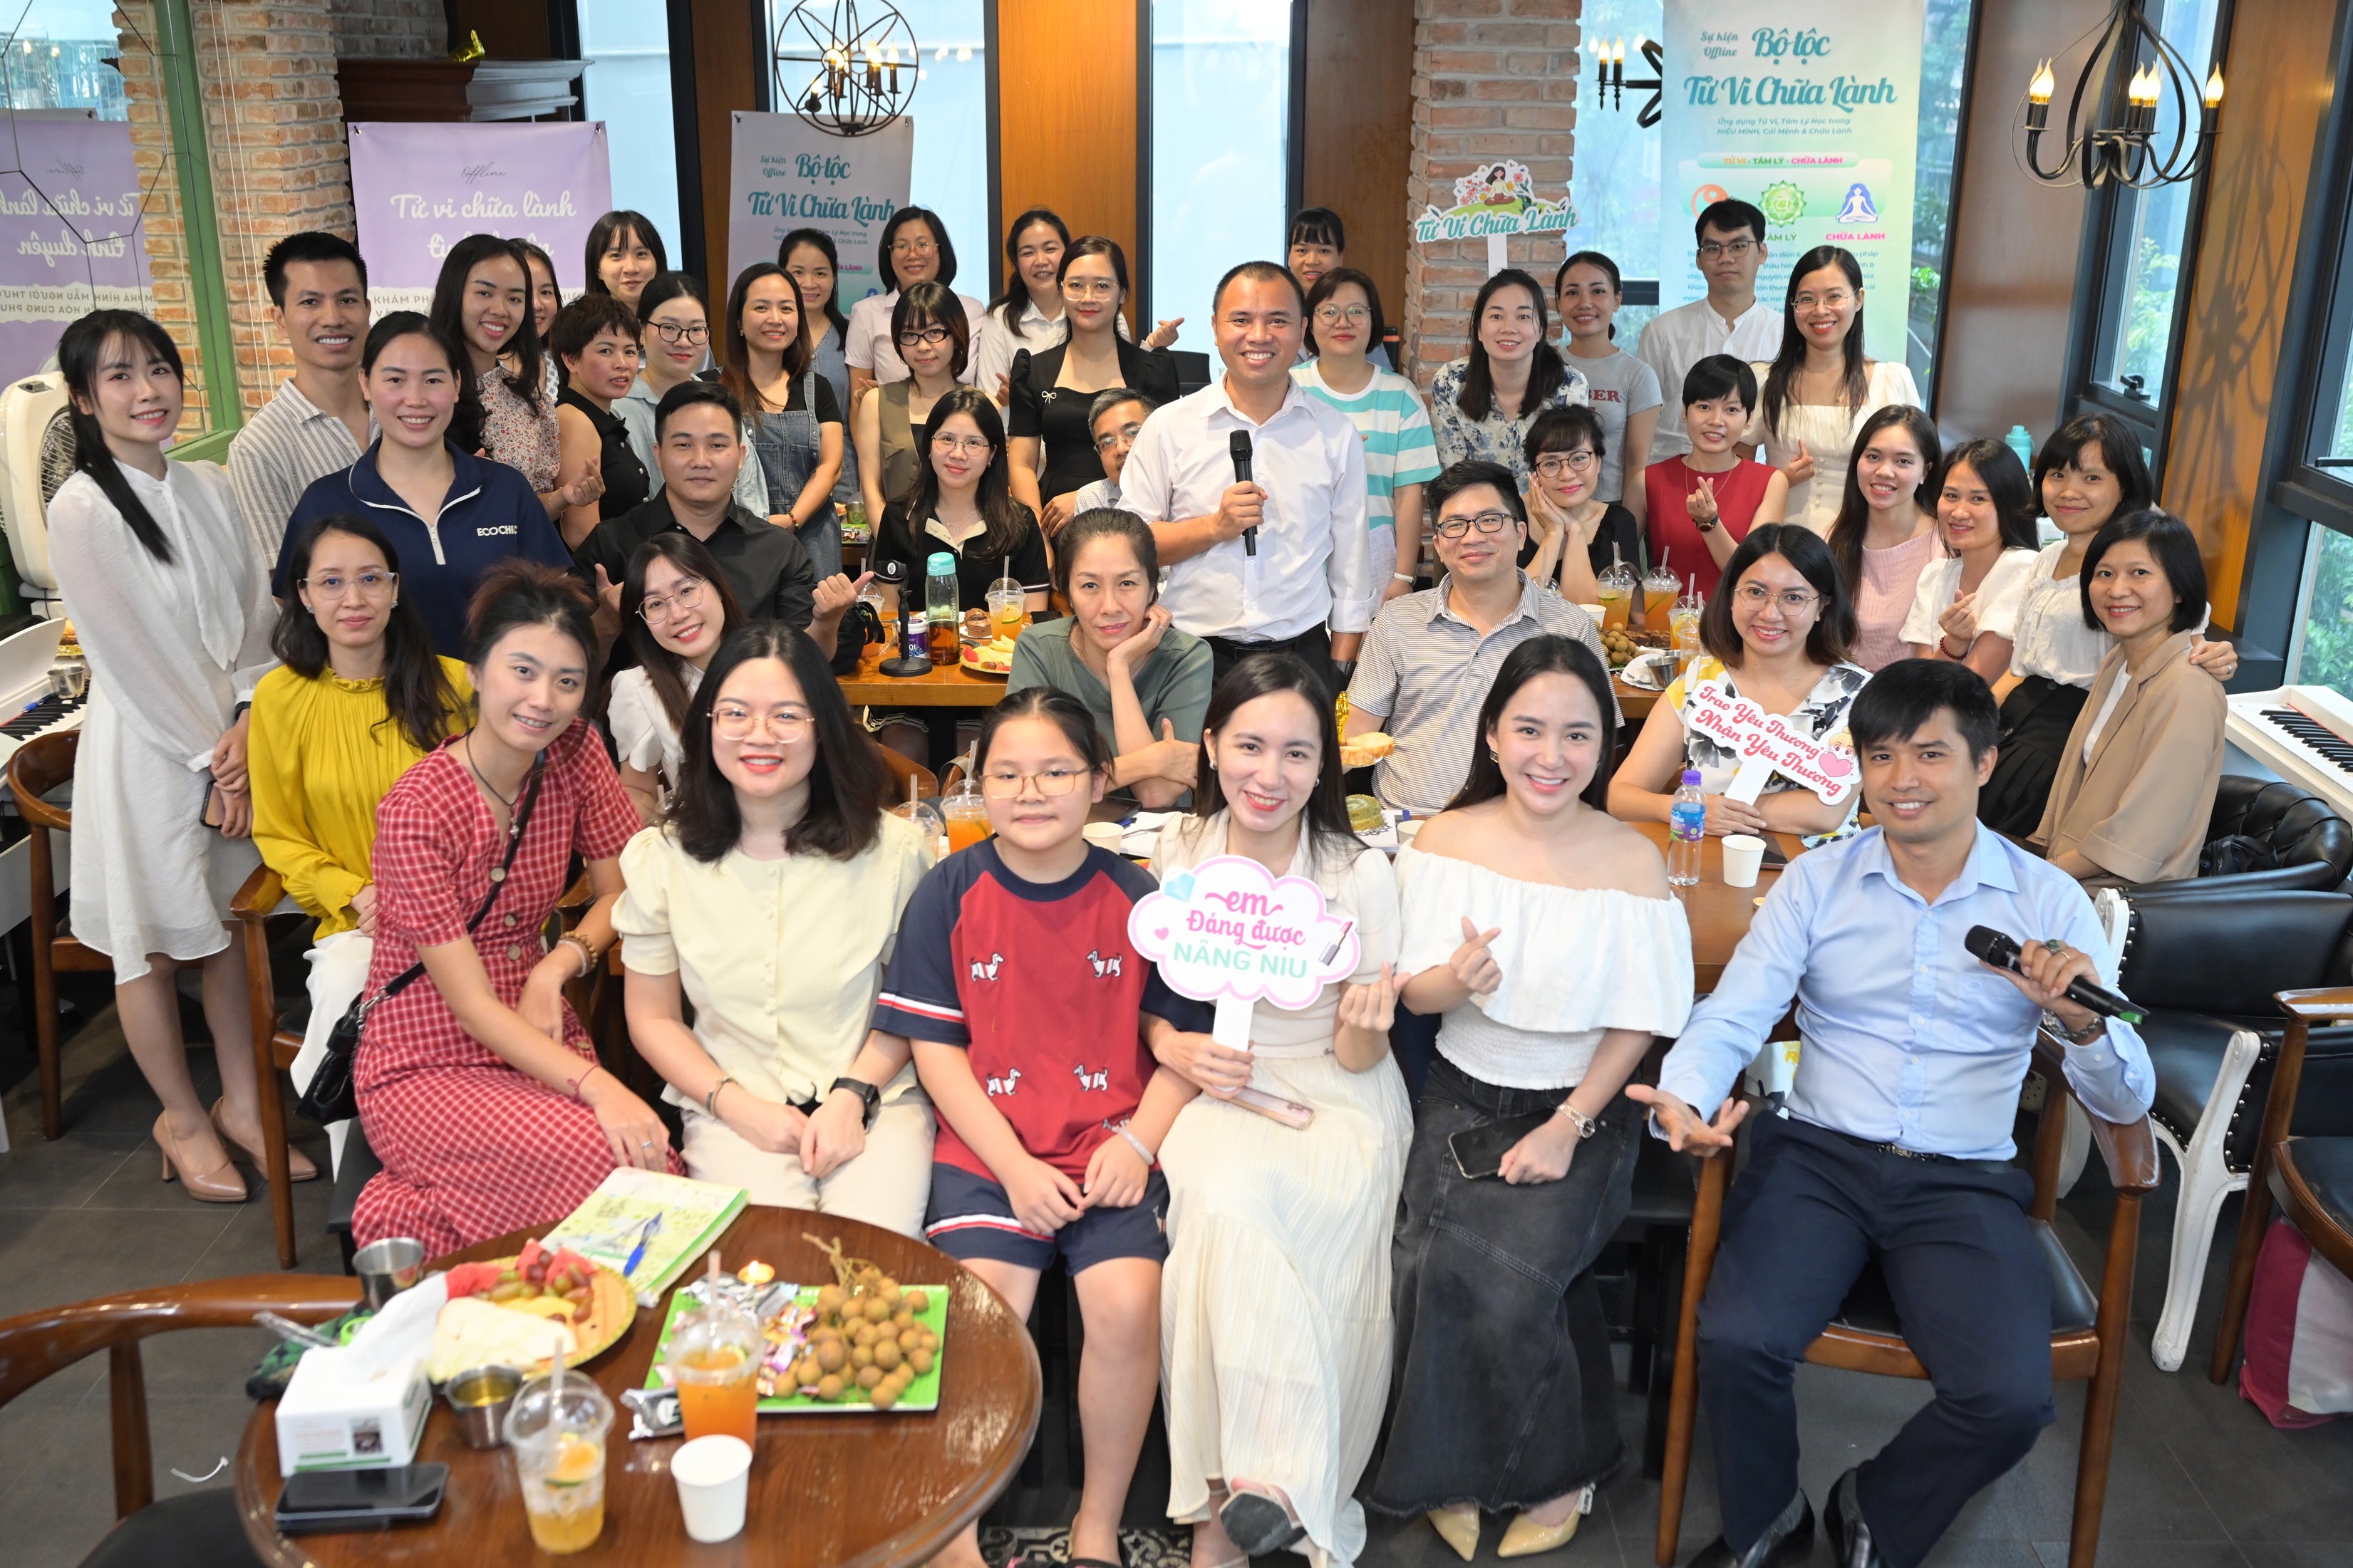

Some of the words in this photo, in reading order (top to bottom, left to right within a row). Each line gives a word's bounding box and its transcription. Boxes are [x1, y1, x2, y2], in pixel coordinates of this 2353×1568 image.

[1700, 31, 1714, 42] Sự
[1717, 31, 1739, 42] kiện
[1703, 46, 1737, 59] Offline
[1752, 27, 1794, 65] Bộ
[1794, 27, 1831, 65] tộc
[1683, 75, 1719, 105] Tử
[1721, 76, 1752, 105] Vi
[1755, 76, 1826, 105] Chữa
[1829, 75, 1898, 113] Lành
[461, 161, 507, 184] Offline
[762, 167, 787, 179] Offline
[795, 152, 822, 185] Bộ
[824, 155, 852, 185] tộc
[433, 198, 457, 218] vi
[461, 190, 518, 218] chữa
[522, 190, 577, 217] lành
[748, 191, 775, 216] Tử
[775, 193, 798, 217] Vi
[800, 194, 850, 219] Chữa
[851, 195, 895, 227] Lành
[1417, 218, 1440, 241] Tử
[1443, 216, 1467, 237] Vi
[1469, 212, 1521, 235] Chữa
[1526, 206, 1579, 232] Lành
[1826, 232, 1855, 241] CHỮA
[1857, 232, 1886, 241] LÀNH
[374, 294, 409, 304] KHÁM
[1699, 685, 1731, 711] Trao
[1732, 702, 1764, 729] Yêu
[1765, 719, 1820, 760] Thương
[1695, 709, 1742, 742] Nhận
[1743, 733, 1779, 762] Yêu
[1781, 752, 1843, 797] Thương
[1204, 891, 1283, 917] em
[1186, 909, 1266, 950] Đáng
[1251, 918, 1306, 950] được
[1173, 939, 1251, 971] NÂNG
[1260, 952, 1307, 979] NIU
